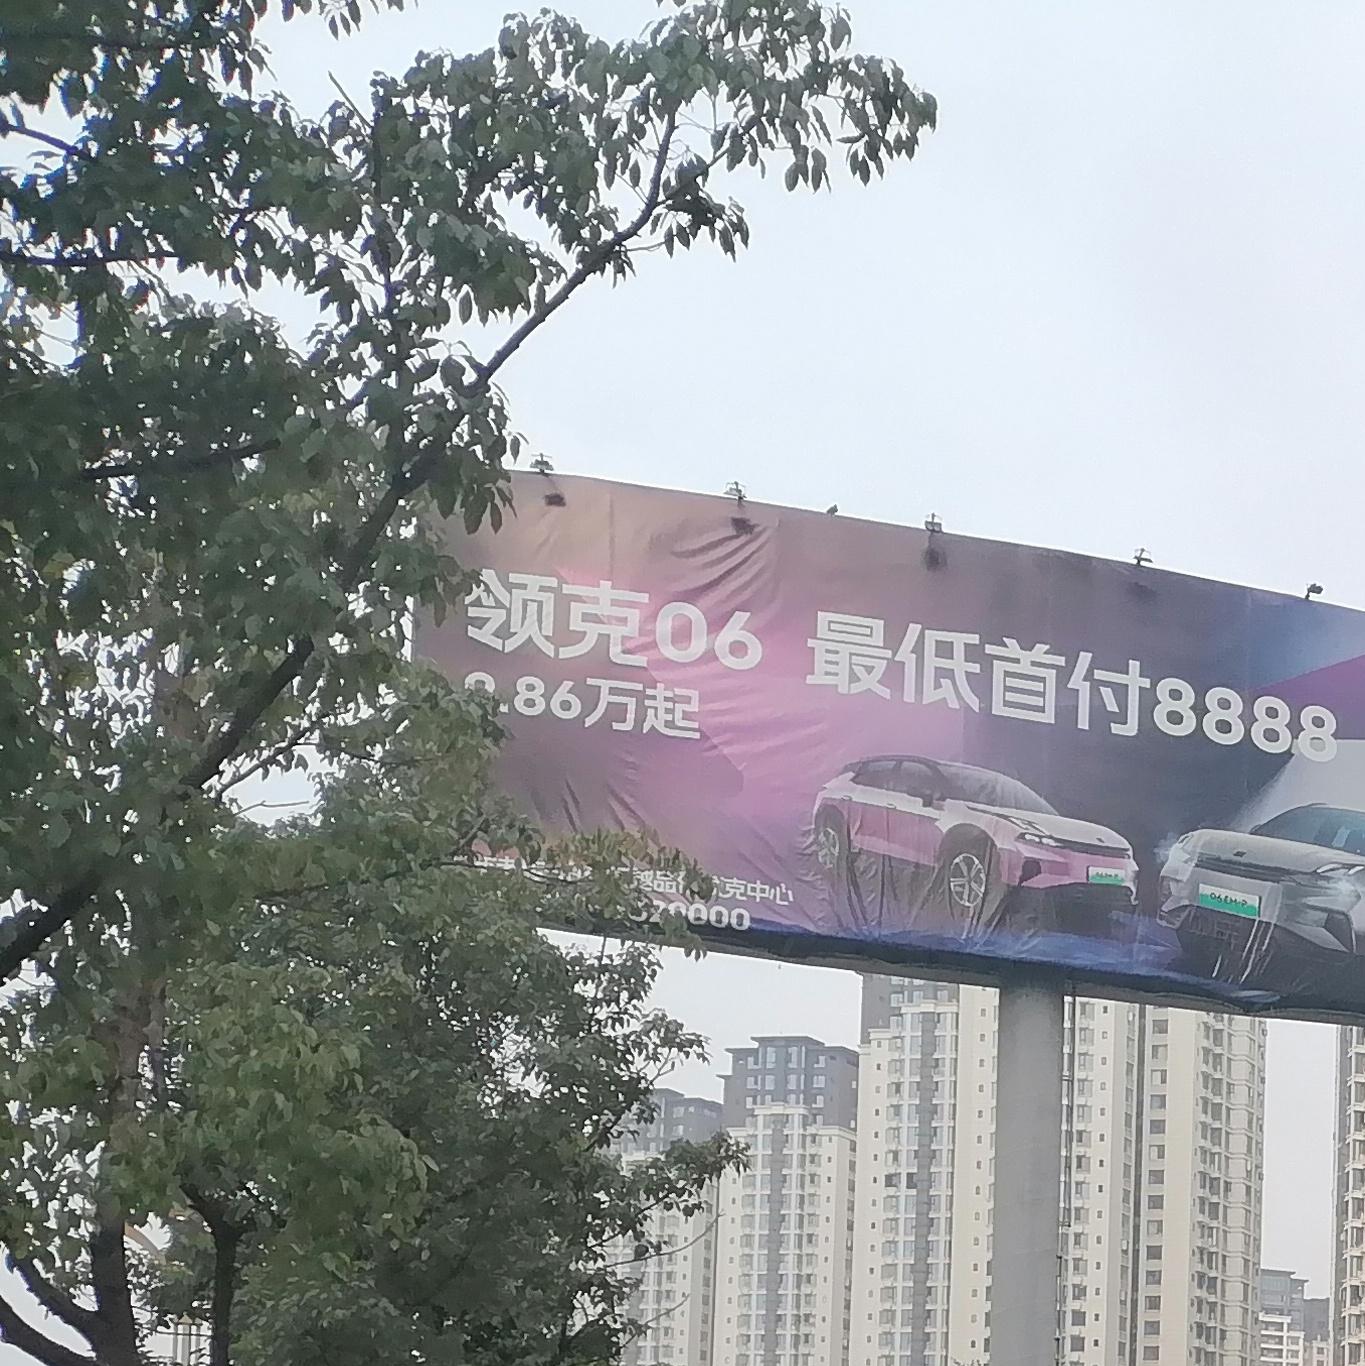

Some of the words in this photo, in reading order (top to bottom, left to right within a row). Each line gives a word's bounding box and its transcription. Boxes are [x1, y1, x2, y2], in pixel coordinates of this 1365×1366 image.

[464, 568, 763, 671] 领克06
[806, 610, 1338, 763] 最低首付8888
